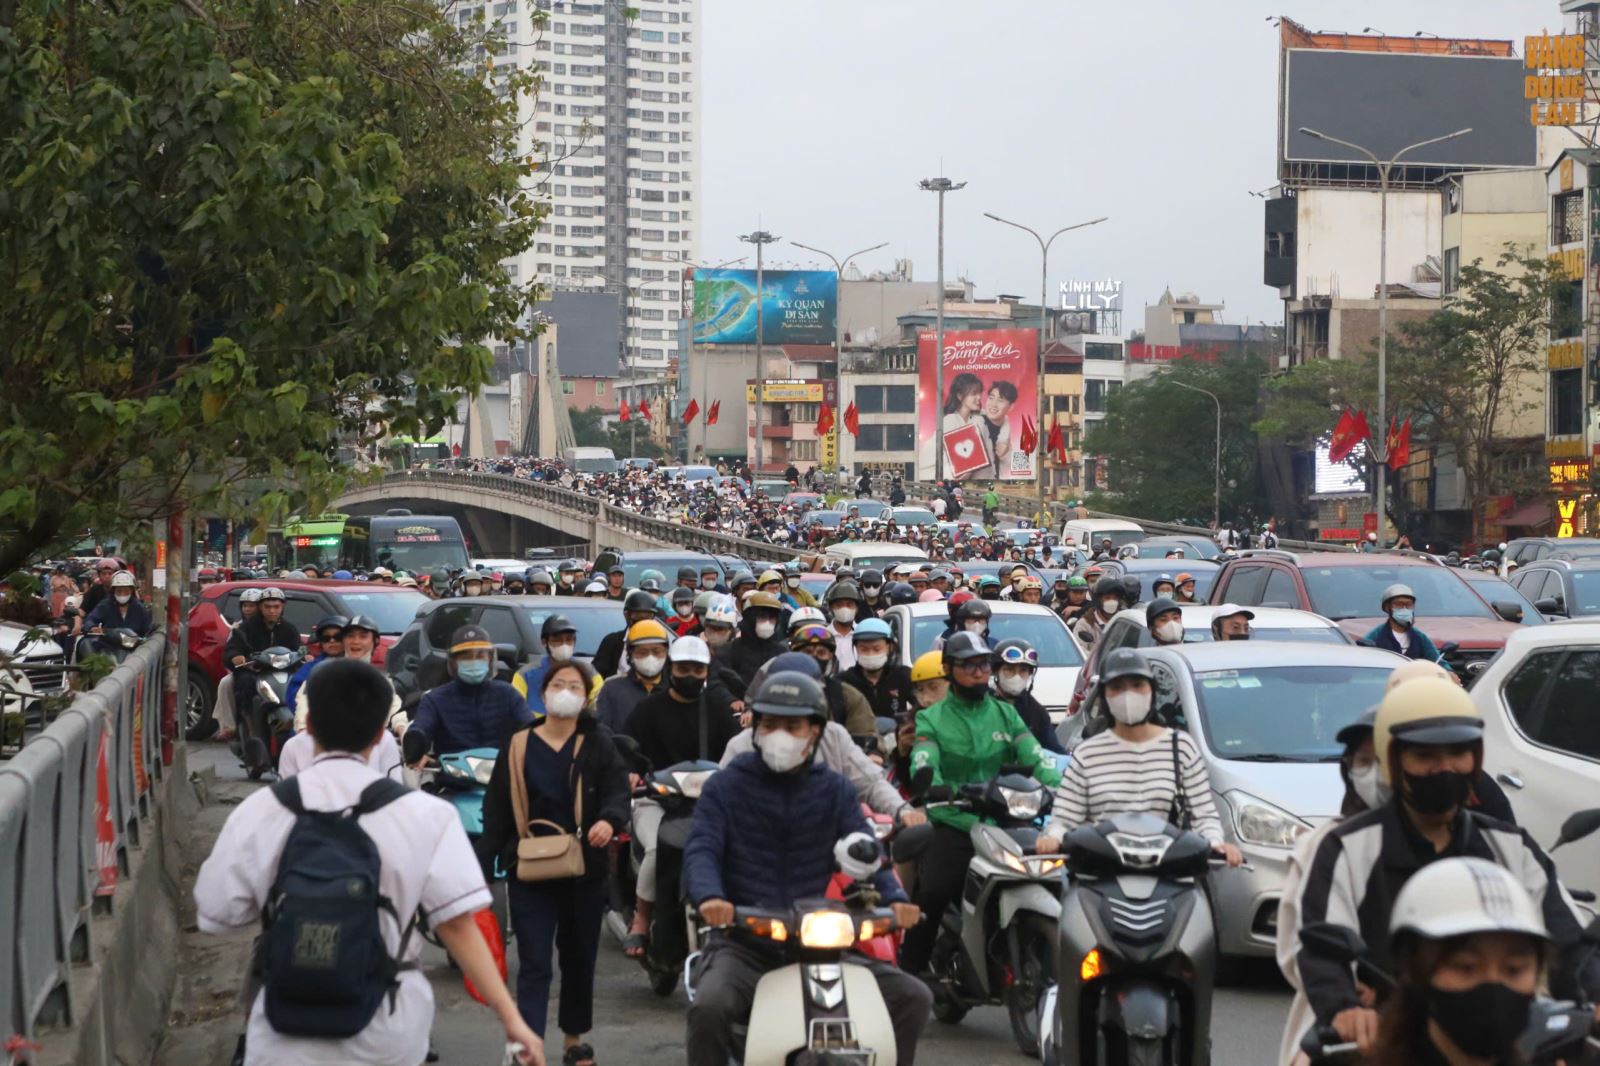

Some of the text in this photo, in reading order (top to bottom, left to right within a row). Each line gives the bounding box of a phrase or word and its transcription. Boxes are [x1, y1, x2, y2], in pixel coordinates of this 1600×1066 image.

[1525, 28, 1585, 69] VÀNG
[1531, 103, 1576, 126] LAN
[1060, 279, 1091, 292] KÍNH
[795, 299, 824, 310] QUAN
[1062, 293, 1119, 309] LILY
[980, 341, 1020, 360] Quà
